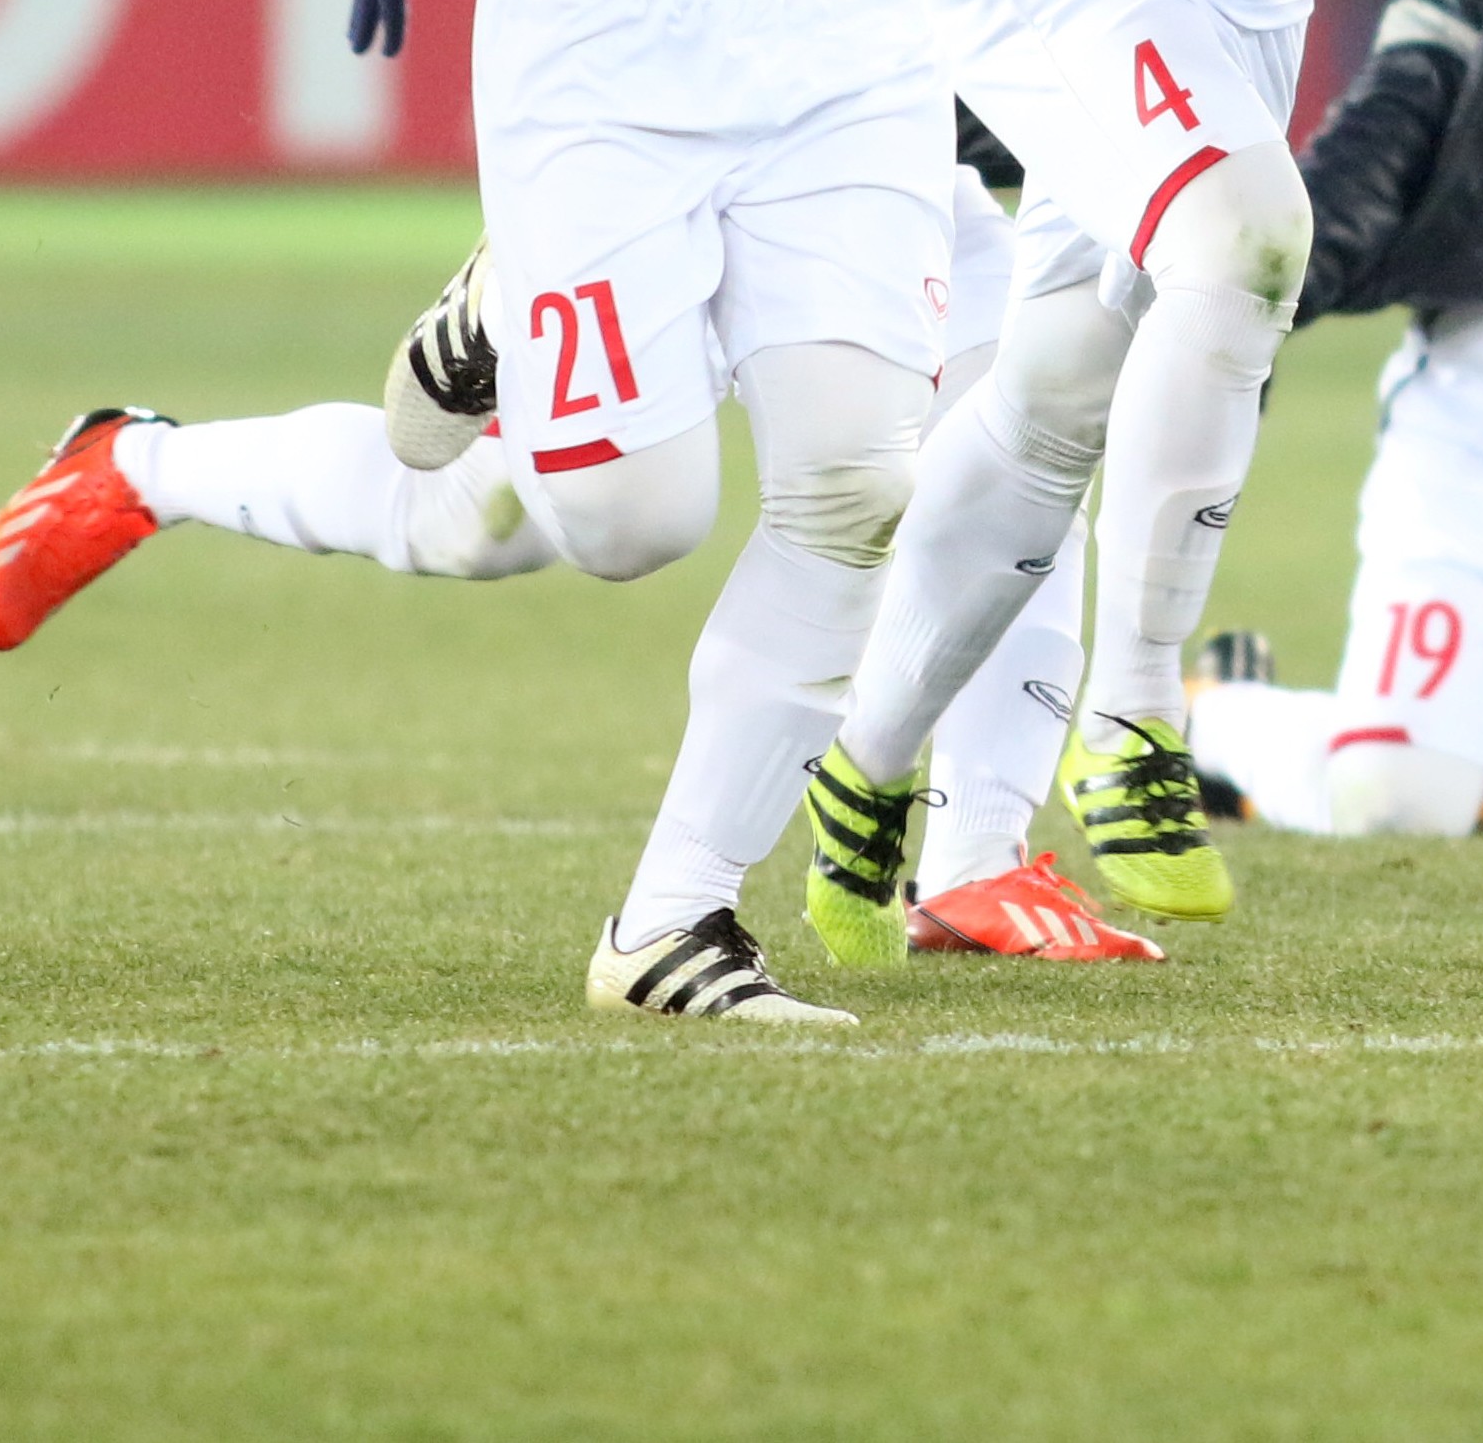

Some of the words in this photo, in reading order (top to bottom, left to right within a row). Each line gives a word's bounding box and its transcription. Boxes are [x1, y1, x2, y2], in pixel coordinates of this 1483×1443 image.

[1134, 39, 1201, 132] 4
[530, 279, 640, 421] 21
[1377, 600, 1463, 699] 19
